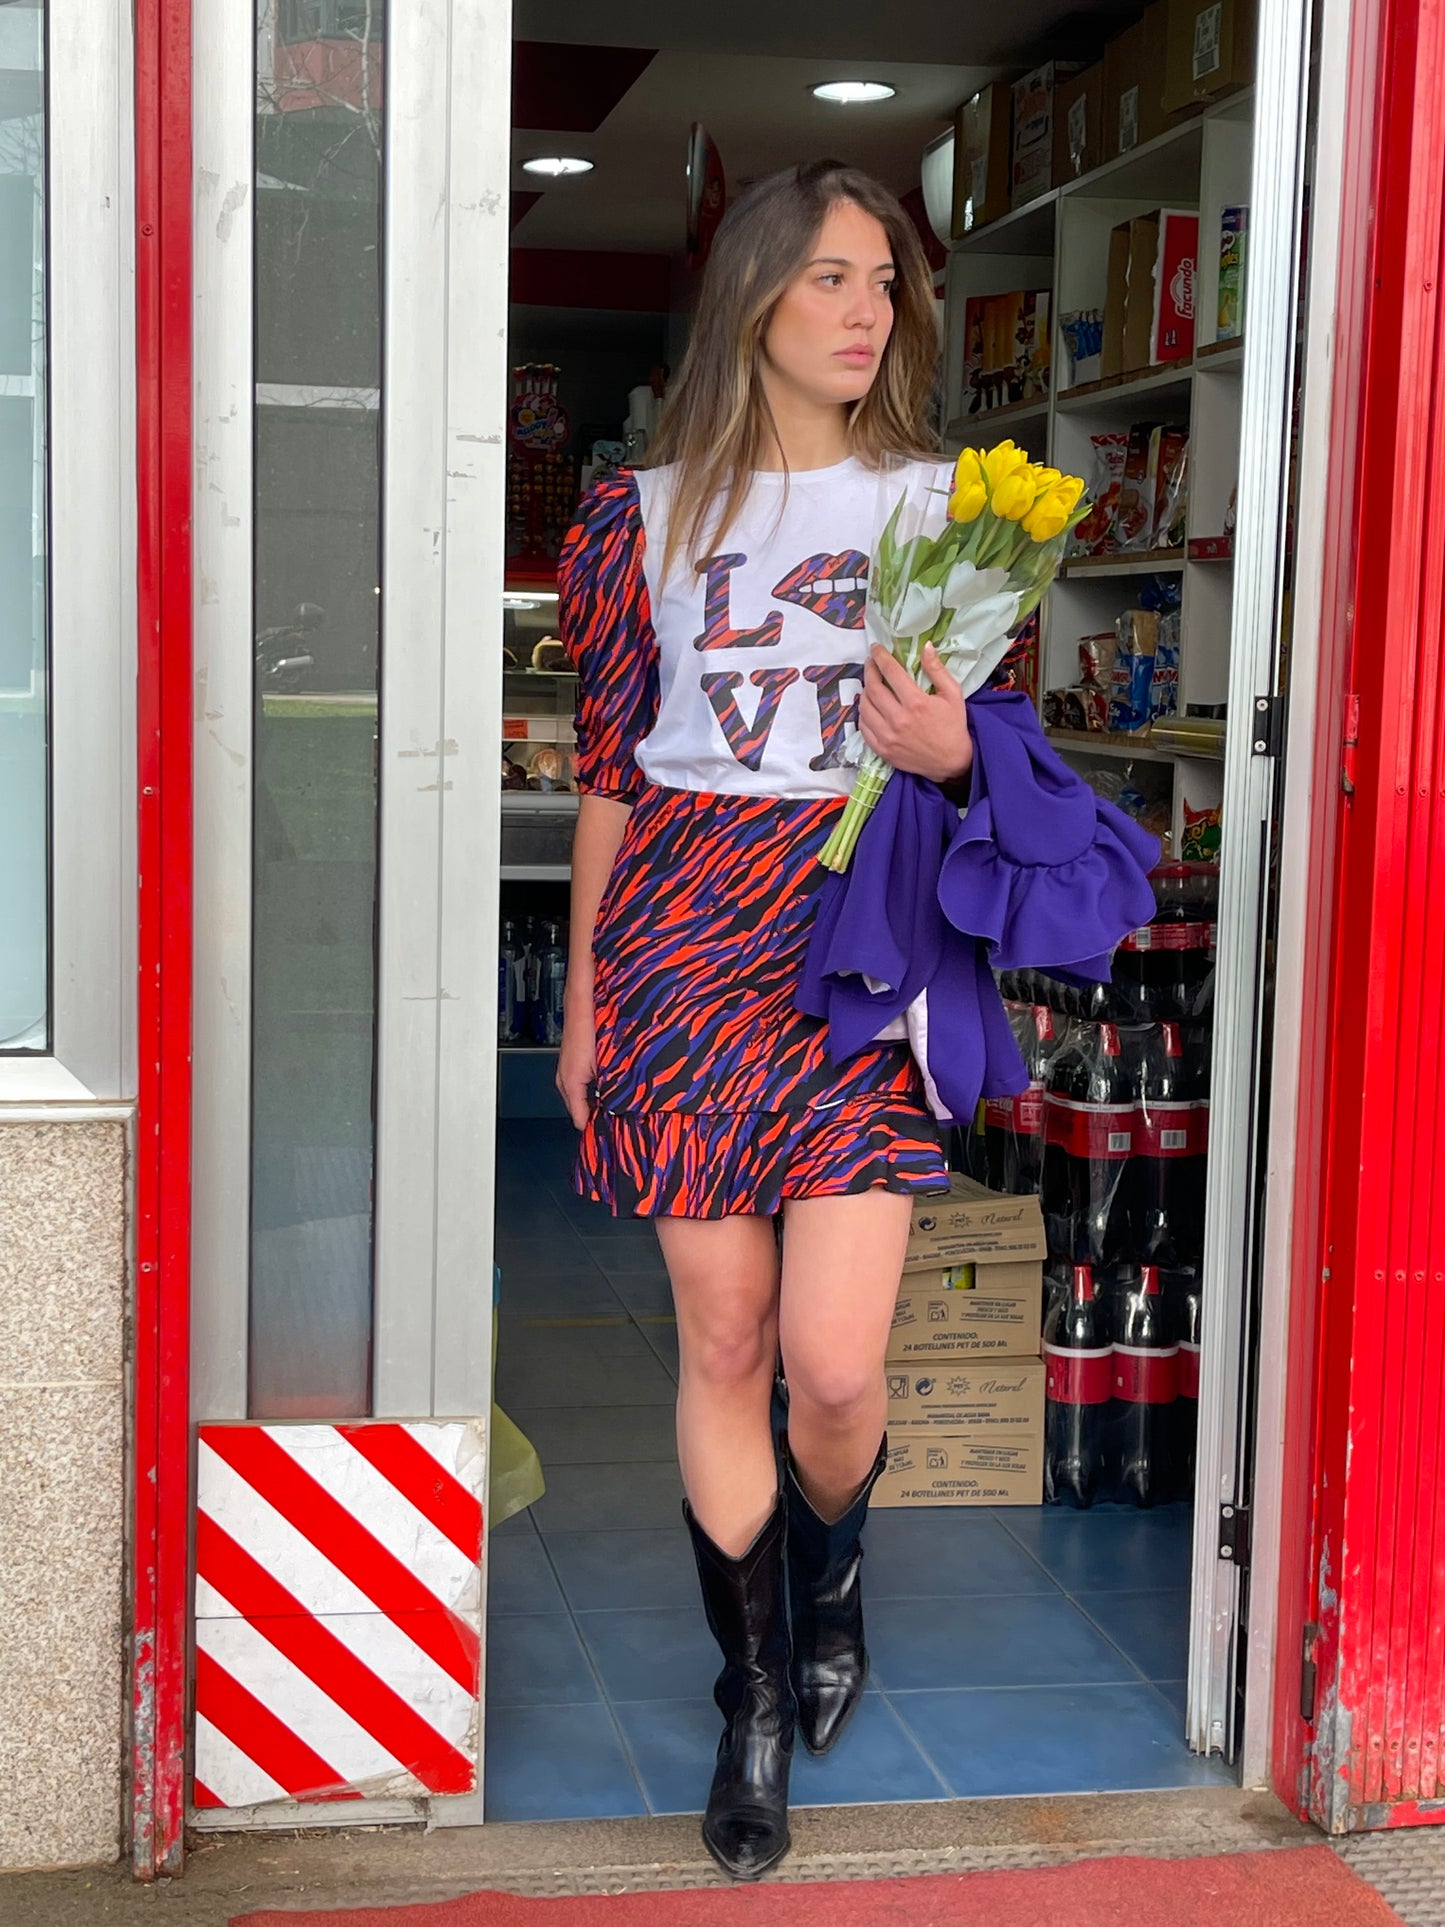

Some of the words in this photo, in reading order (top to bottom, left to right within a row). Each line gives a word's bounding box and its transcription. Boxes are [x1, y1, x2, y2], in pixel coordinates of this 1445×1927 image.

[1177, 260, 1193, 317] facundo
[981, 1208, 1025, 1225] Natural
[932, 1331, 978, 1341] CONTENIDO:
[903, 1343, 912, 1352] 24
[913, 1342, 955, 1351] BOTELLINES
[956, 1341, 970, 1349] PET
[979, 1377, 1027, 1394] Natural
[931, 1480, 978, 1488] CONTENIDO:
[900, 1490, 910, 1498] 24
[911, 1490, 955, 1498] BOTELLINES
[956, 1489, 970, 1497] PET
